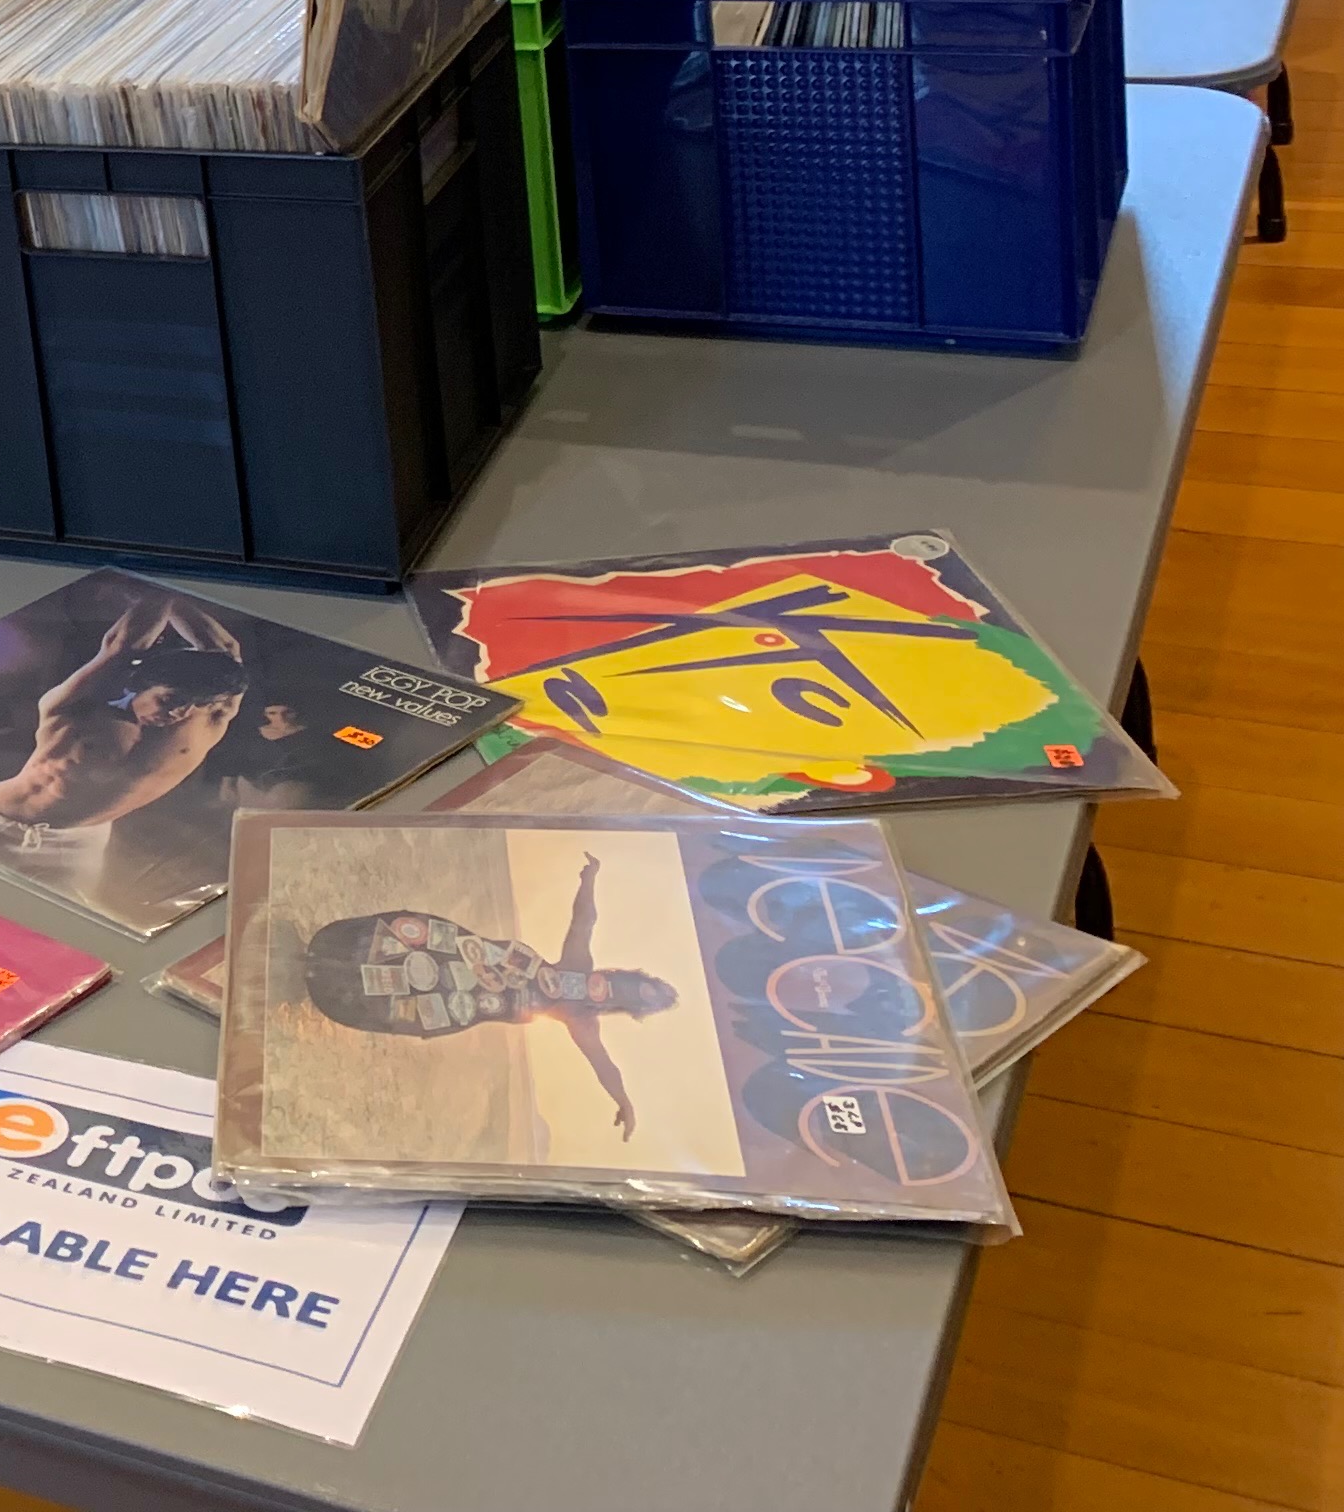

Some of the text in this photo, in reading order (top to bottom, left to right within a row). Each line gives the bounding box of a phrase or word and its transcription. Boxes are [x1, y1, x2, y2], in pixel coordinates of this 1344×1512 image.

[340, 681, 461, 727] new values
[360, 667, 488, 709] IGGY POP
[6, 1168, 140, 1210] ZEALAND
[155, 1204, 279, 1242] LIMITED
[166, 1257, 340, 1330] HERE
